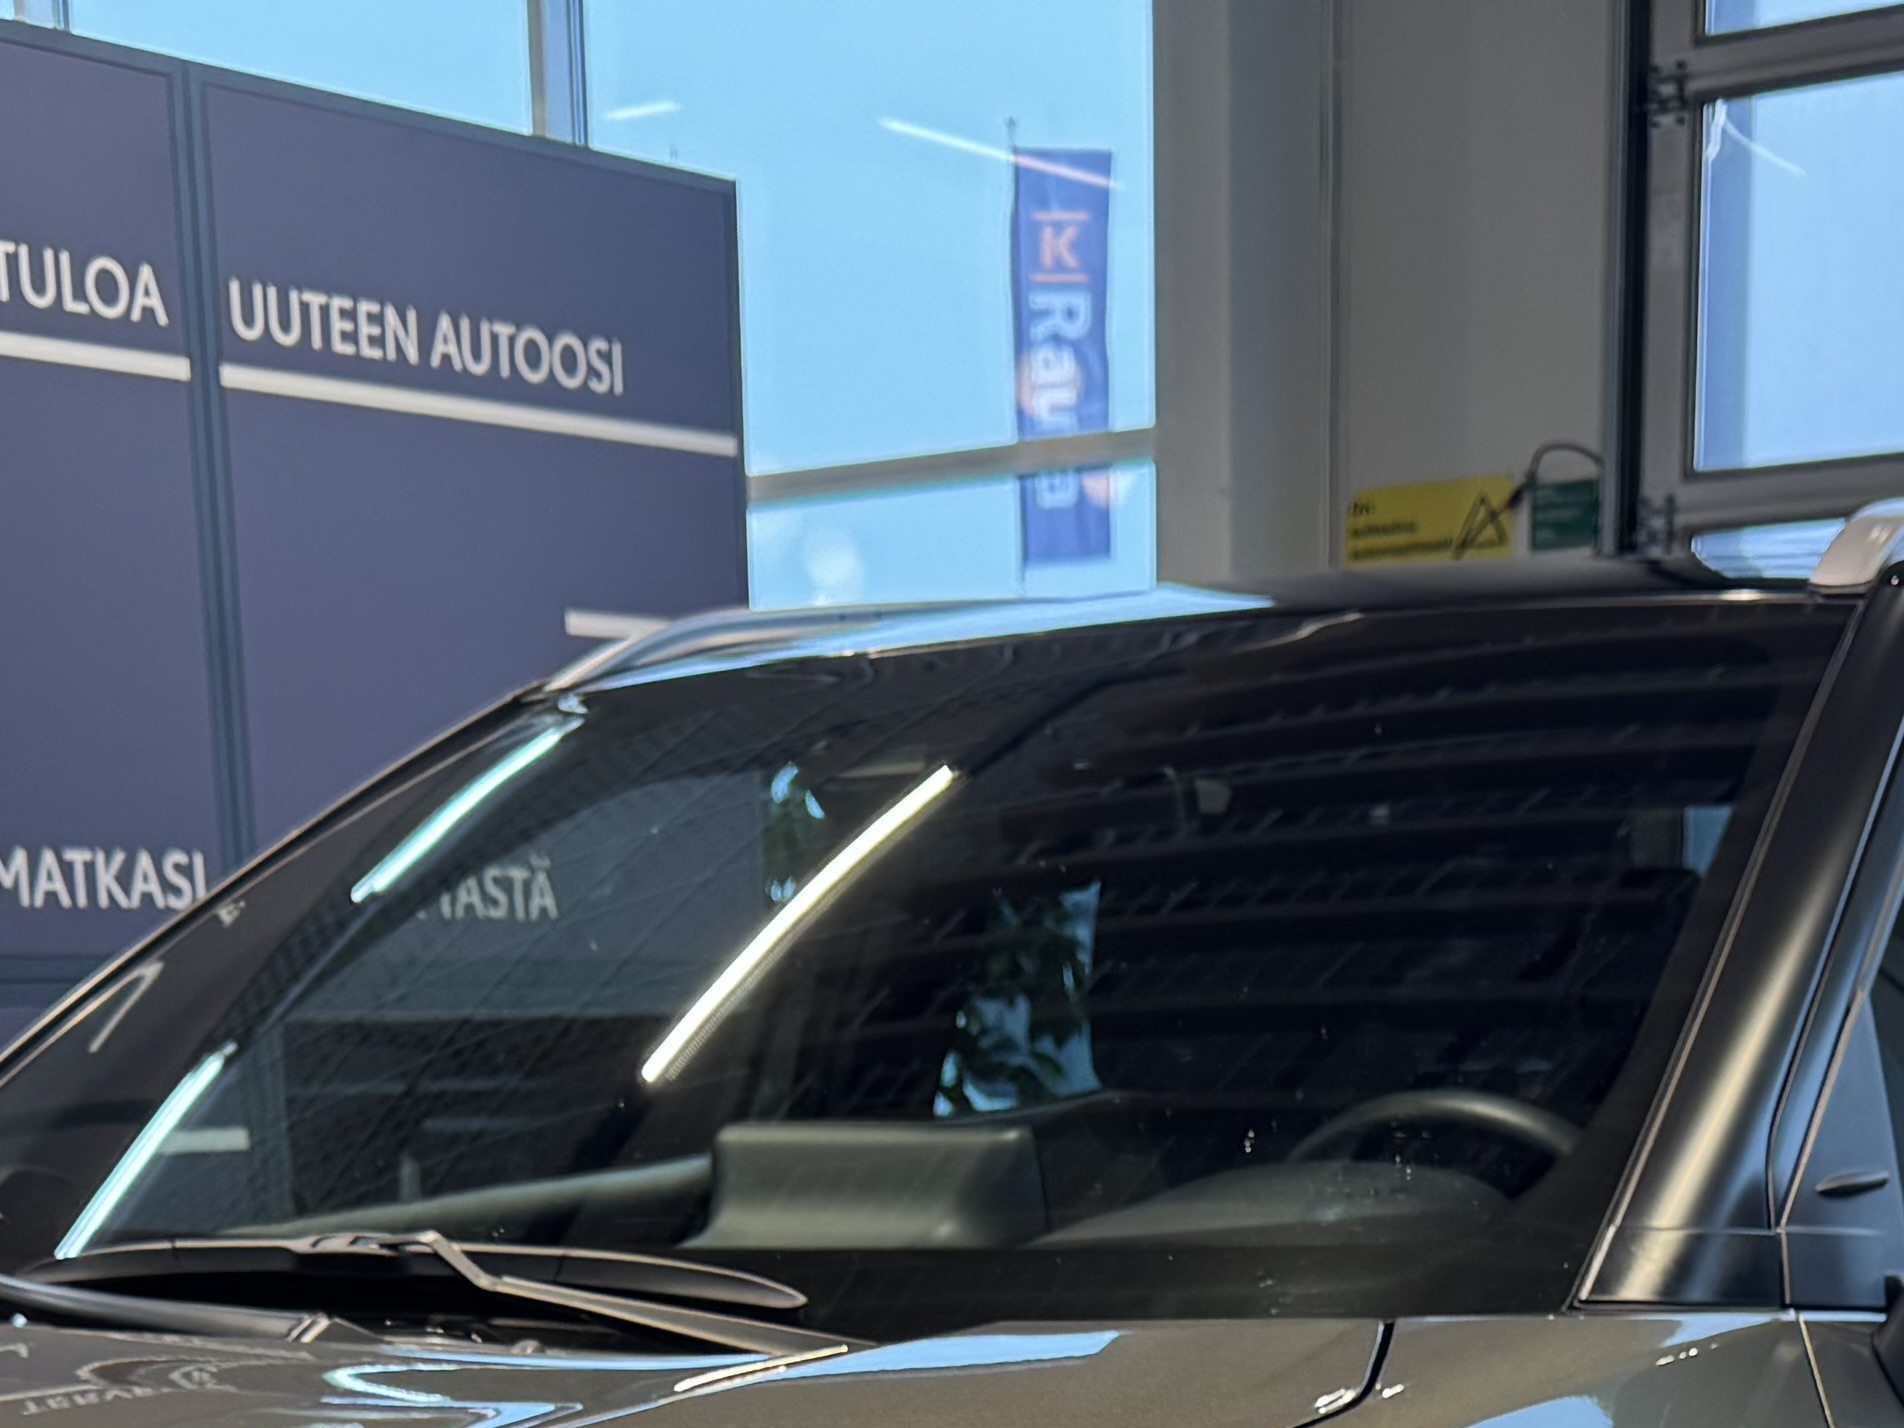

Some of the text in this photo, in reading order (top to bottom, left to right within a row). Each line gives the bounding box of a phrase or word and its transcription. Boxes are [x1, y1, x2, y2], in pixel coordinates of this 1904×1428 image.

[228, 276, 418, 367] UUTEEN
[429, 308, 624, 396] AUTOOSI
[1028, 286, 1092, 510] Raua
